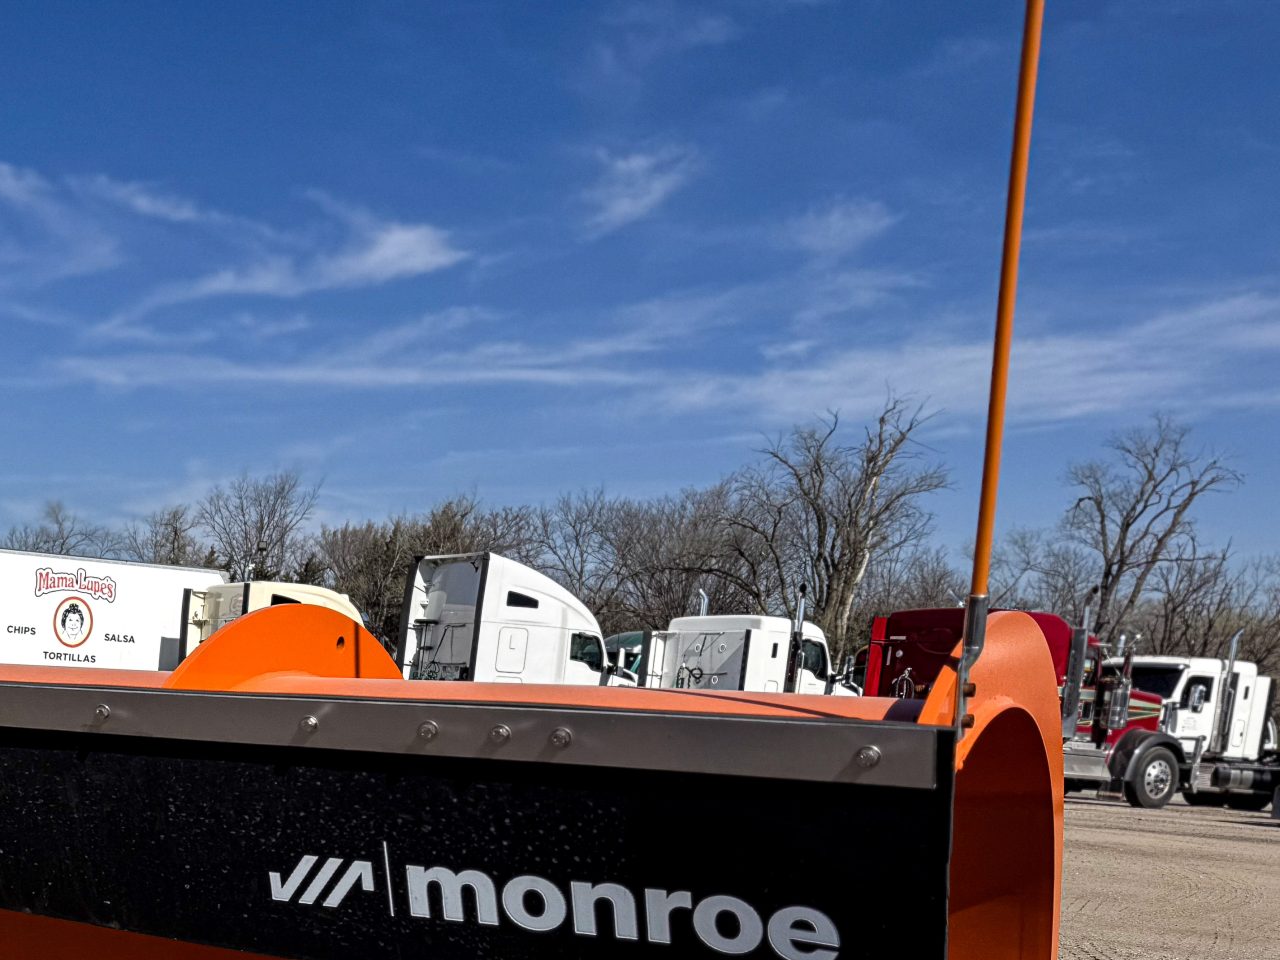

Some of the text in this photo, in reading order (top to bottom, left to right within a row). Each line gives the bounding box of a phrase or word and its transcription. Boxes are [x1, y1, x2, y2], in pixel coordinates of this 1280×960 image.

[38, 571, 114, 599] Mama Lupe's
[6, 625, 37, 636] CHIPS
[104, 633, 136, 644] SALSA
[43, 651, 97, 663] TORTILLAS
